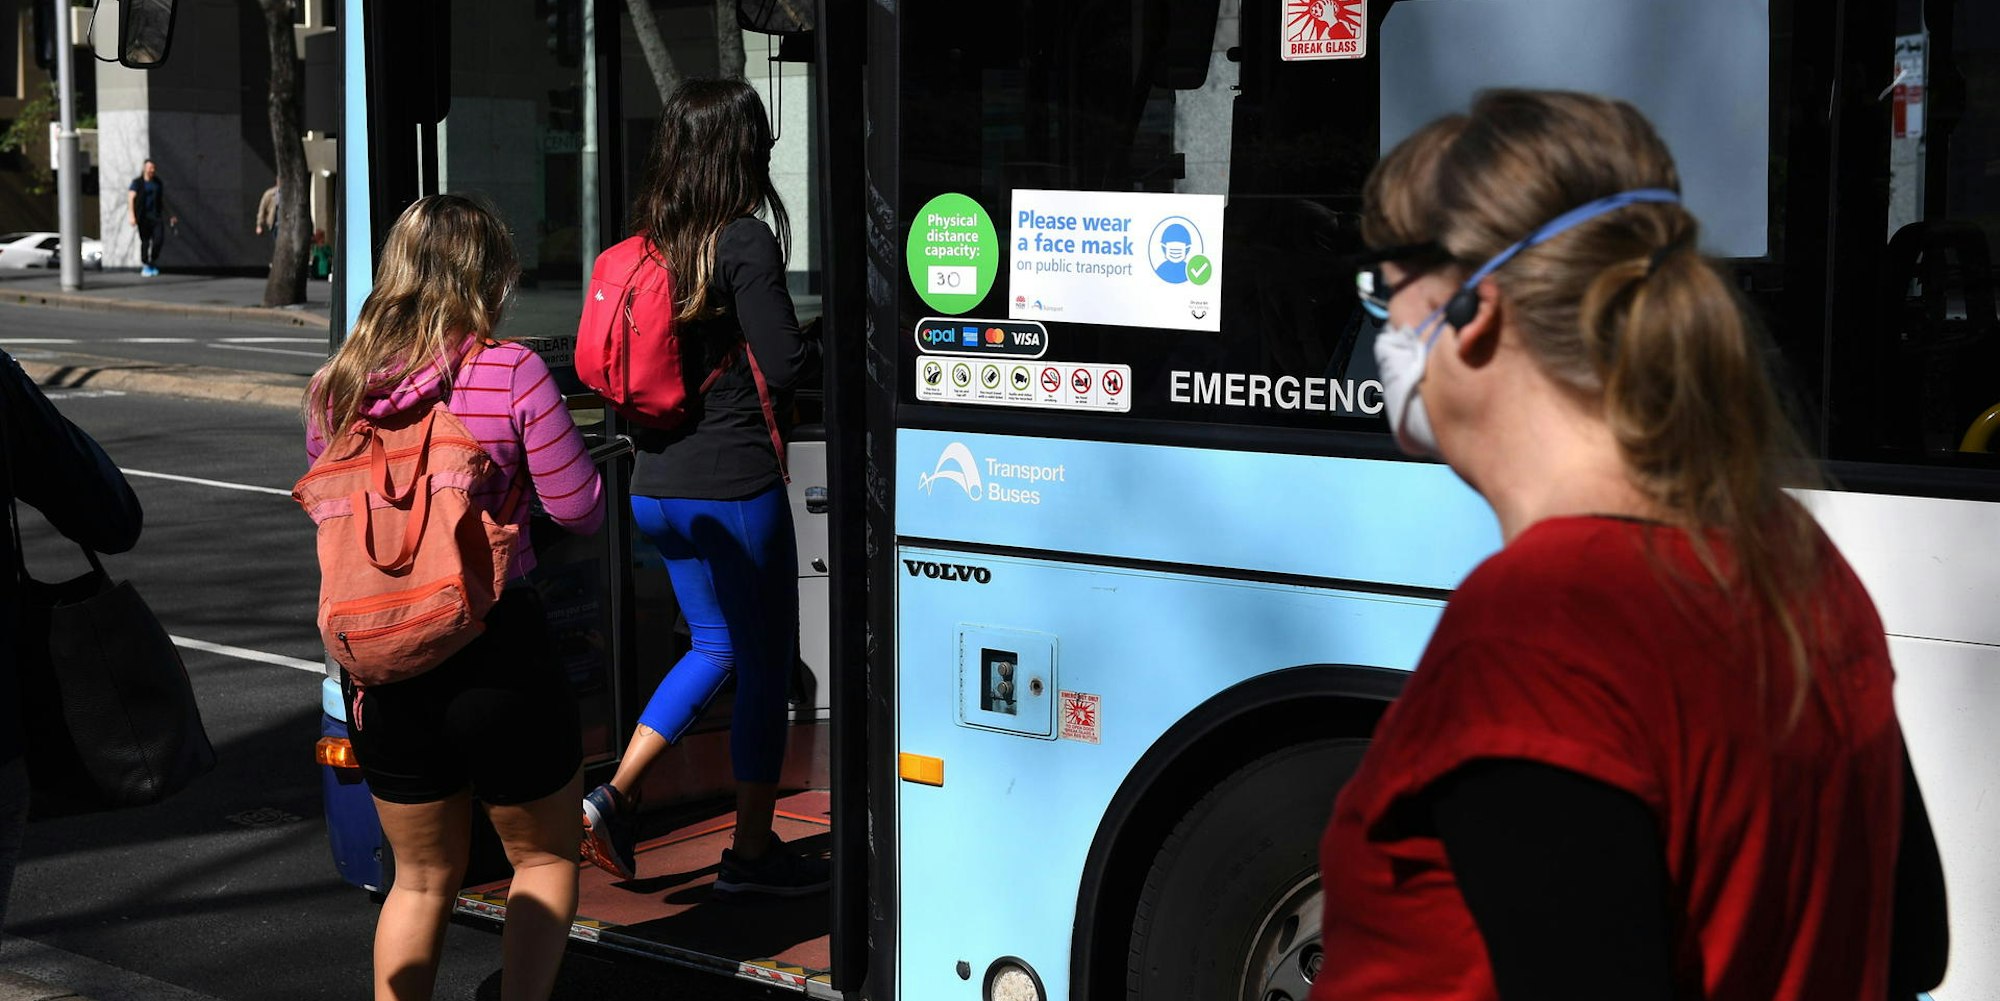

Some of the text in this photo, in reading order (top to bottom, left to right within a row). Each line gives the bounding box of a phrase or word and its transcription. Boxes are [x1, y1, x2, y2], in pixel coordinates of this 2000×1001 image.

[1291, 41, 1357, 54] BREAK GLASS
[928, 213, 977, 229] Physical
[1018, 210, 1132, 232] Please wear
[927, 229, 979, 242] distance
[1017, 232, 1134, 256] a face mask
[925, 243, 980, 260] capacity:
[1017, 258, 1133, 278] on public transport
[936, 271, 961, 288] 30
[923, 327, 955, 346] opal
[1011, 331, 1040, 346] VISA
[1170, 370, 1384, 415] EMERGENC
[985, 457, 1065, 483] Transport
[988, 482, 1041, 505] Buses
[903, 559, 992, 585] VOLVO
